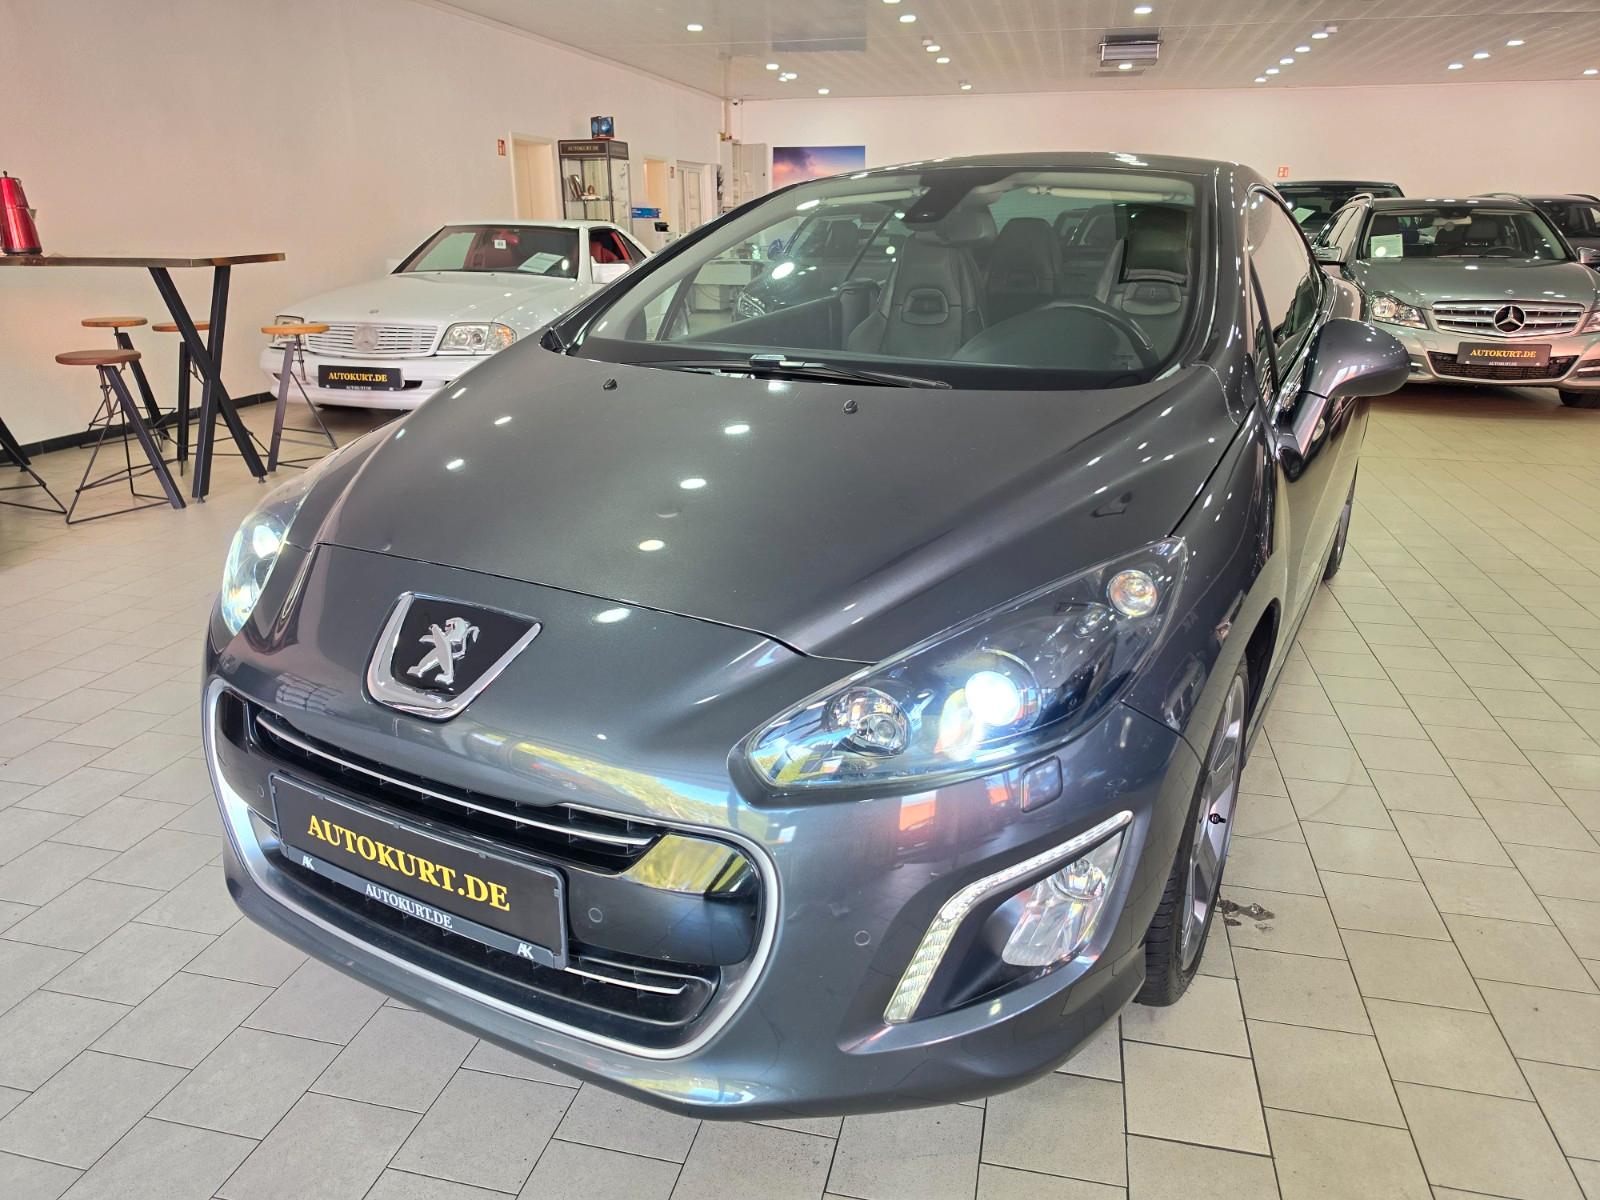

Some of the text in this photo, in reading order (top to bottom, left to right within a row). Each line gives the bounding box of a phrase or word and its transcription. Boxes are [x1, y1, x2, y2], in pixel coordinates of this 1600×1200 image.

[1470, 349, 1537, 358] AUTOKURT.DE
[328, 371, 388, 382] AUTOKURT.DE
[302, 855, 316, 871] AK
[307, 815, 511, 912] AUTOKURT.DE
[365, 883, 453, 930] AUTOKURT.DE
[517, 942, 536, 959] AK
